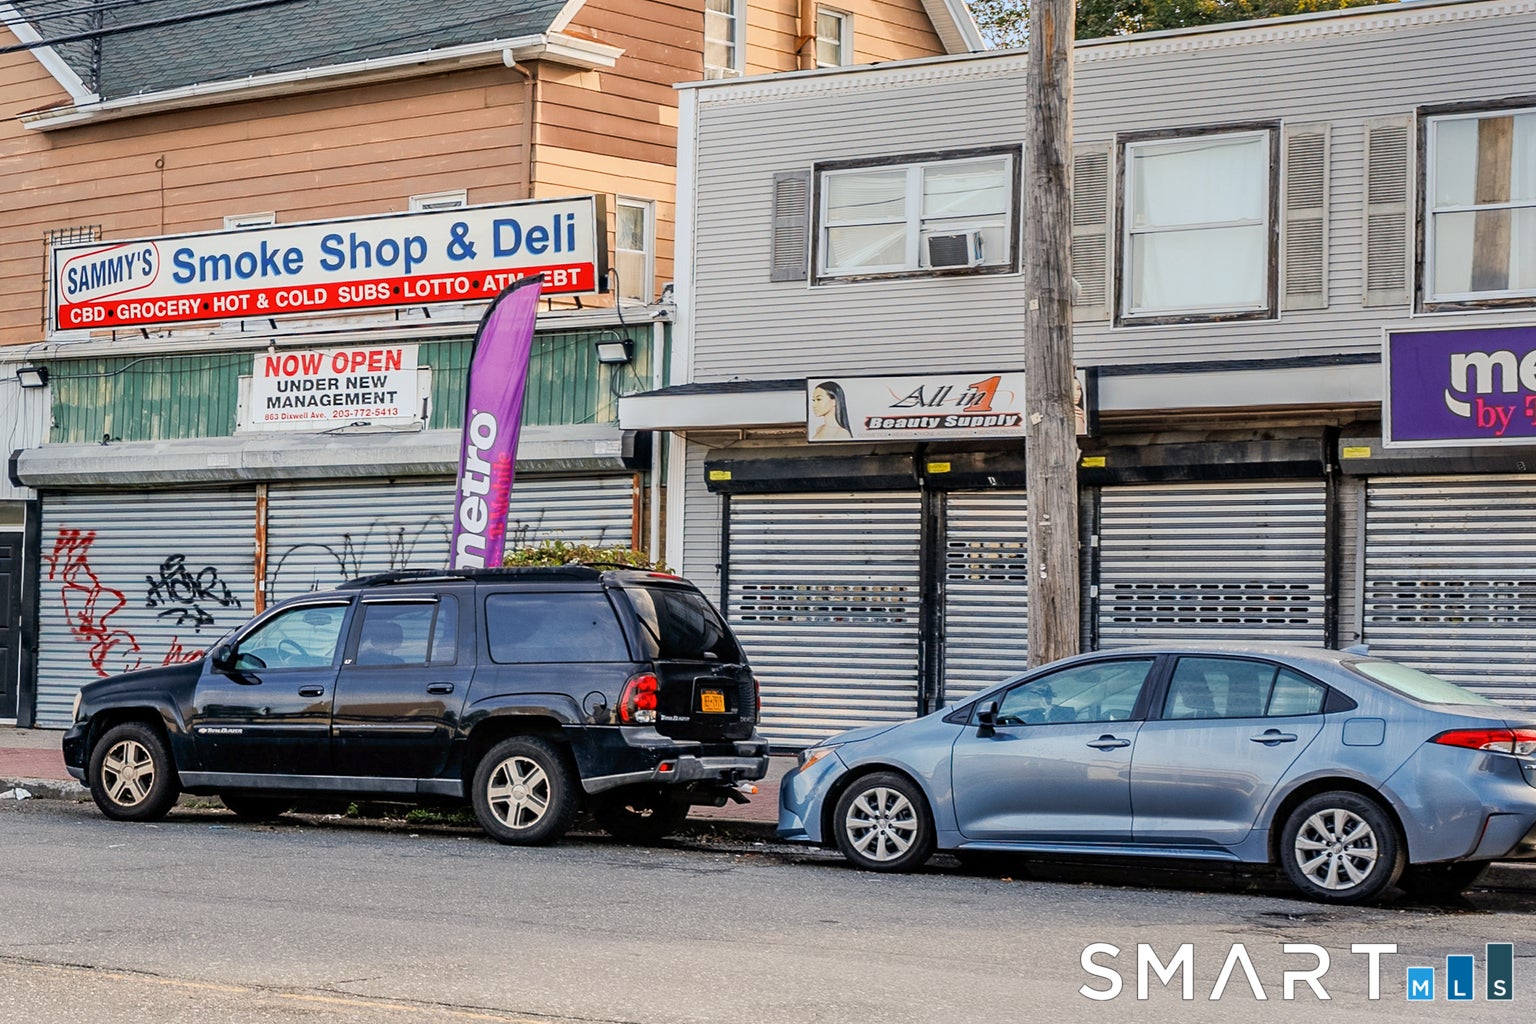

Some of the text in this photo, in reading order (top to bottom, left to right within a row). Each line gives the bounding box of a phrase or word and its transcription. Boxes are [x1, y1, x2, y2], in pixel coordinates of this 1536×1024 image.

[67, 213, 576, 295] SAMMY'S Smoke Shop & Deli
[69, 306, 106, 324] CBD
[116, 298, 202, 320] GROCERY
[213, 293, 251, 313] HOT
[256, 293, 270, 309] &
[275, 288, 328, 307] COLD
[338, 282, 391, 303] SUBS
[404, 276, 470, 298] LOTTO
[540, 268, 581, 287] EBT
[264, 349, 402, 377] NOW OPEN
[277, 375, 388, 392] UNDER NEW
[889, 375, 1001, 413] All in 1
[266, 391, 398, 409] MANAGEMENT
[281, 412, 309, 420] Dixwell
[310, 411, 327, 419] Ave.
[332, 407, 399, 419] 203-772-5413
[869, 414, 1018, 429] Beauty Supply
[1476, 396, 1517, 436] by
